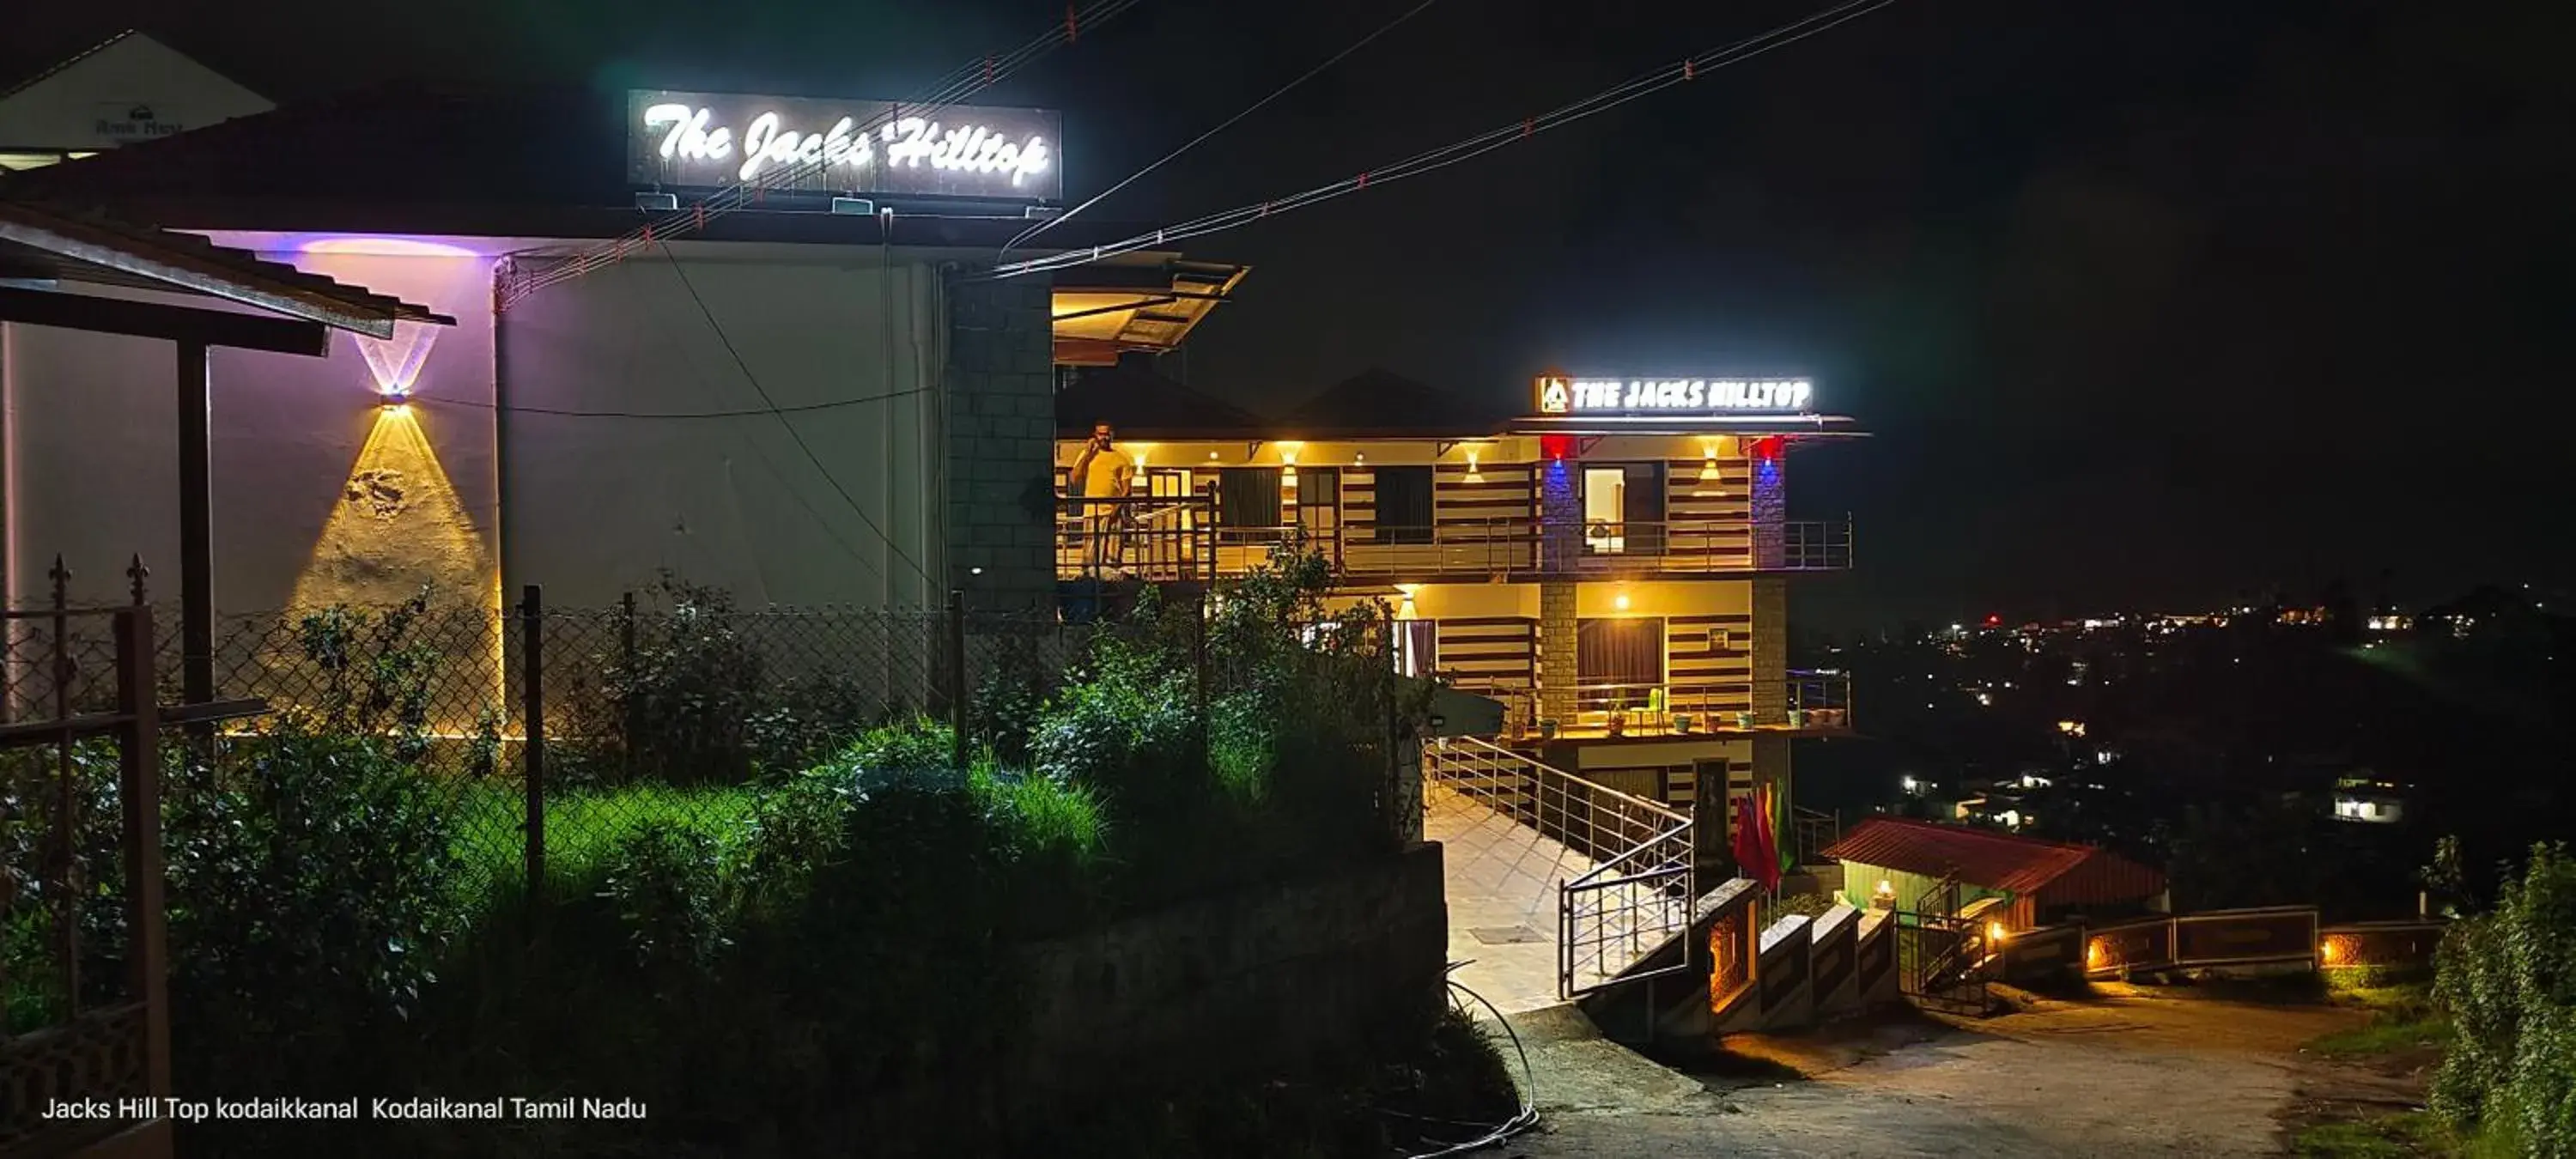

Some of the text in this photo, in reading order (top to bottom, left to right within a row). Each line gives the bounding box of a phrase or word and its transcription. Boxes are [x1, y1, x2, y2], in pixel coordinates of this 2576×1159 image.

[645, 104, 1049, 187] The Jacks Hilltop
[1572, 380, 1812, 408] THE JACKS HILLTOP
